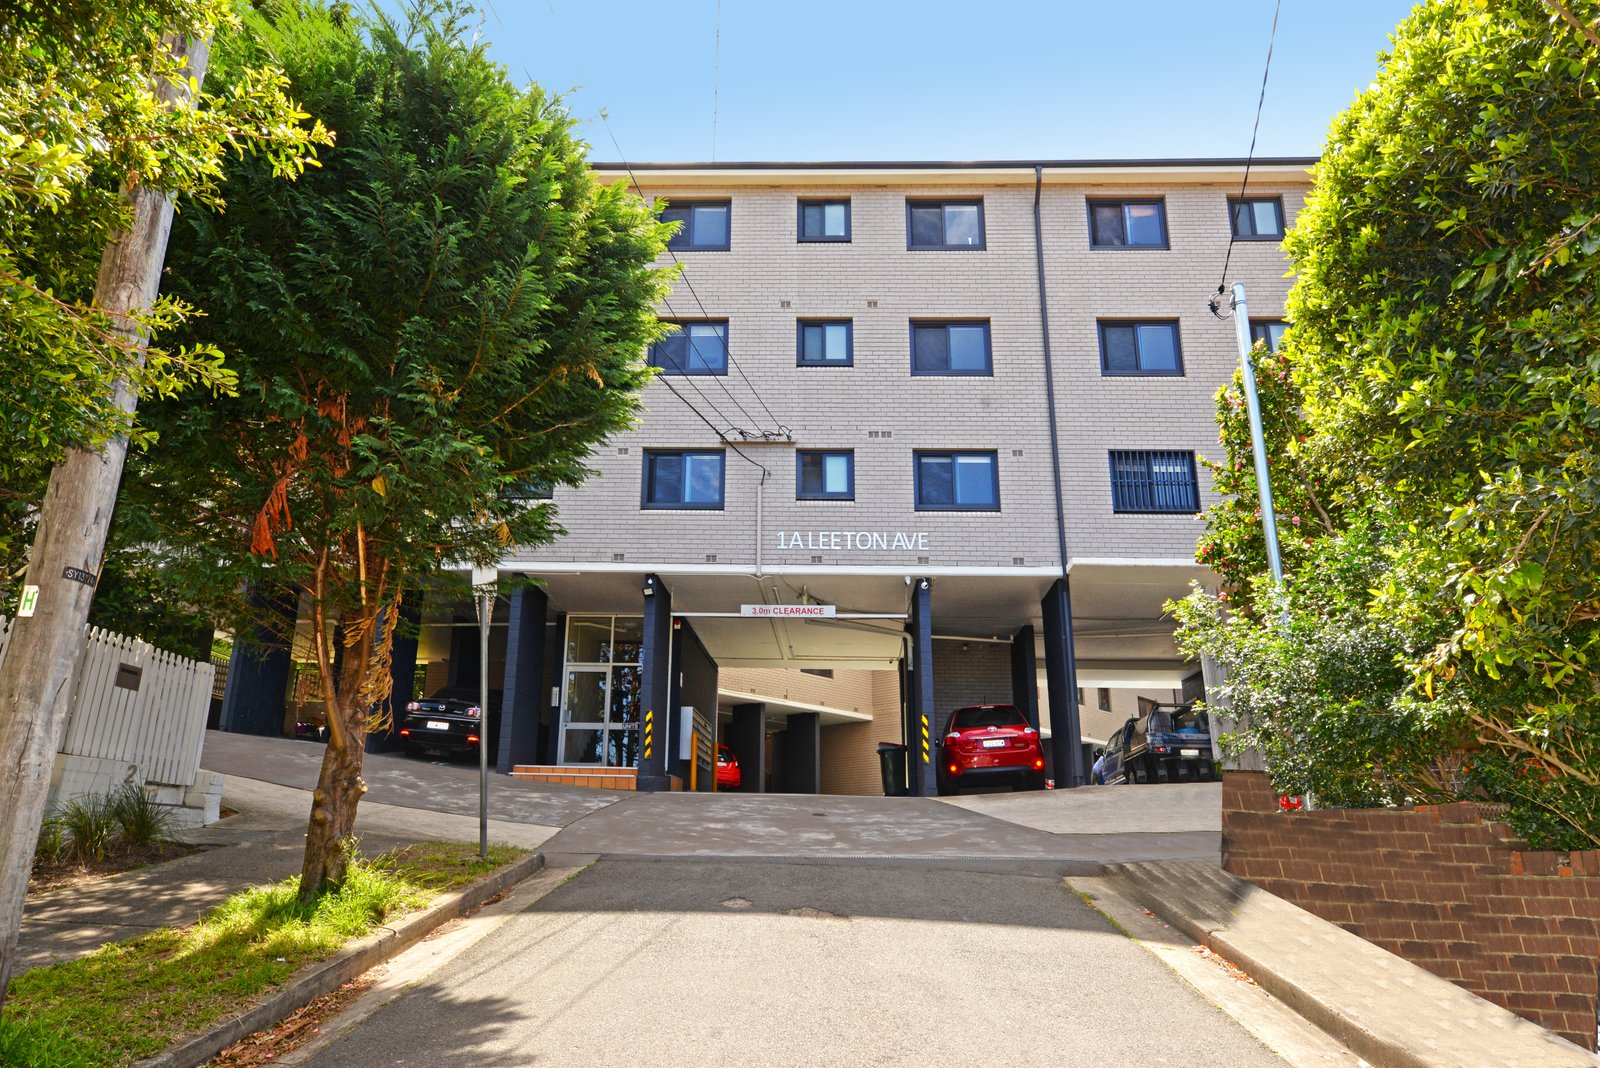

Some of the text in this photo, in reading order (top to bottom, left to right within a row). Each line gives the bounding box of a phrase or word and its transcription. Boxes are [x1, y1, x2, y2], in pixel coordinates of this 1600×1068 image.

[776, 531, 929, 550] 1A LEETON AVE
[22, 591, 36, 611] H
[752, 607, 825, 615] 3.0m CLEARANCE
[123, 764, 138, 784] 2
